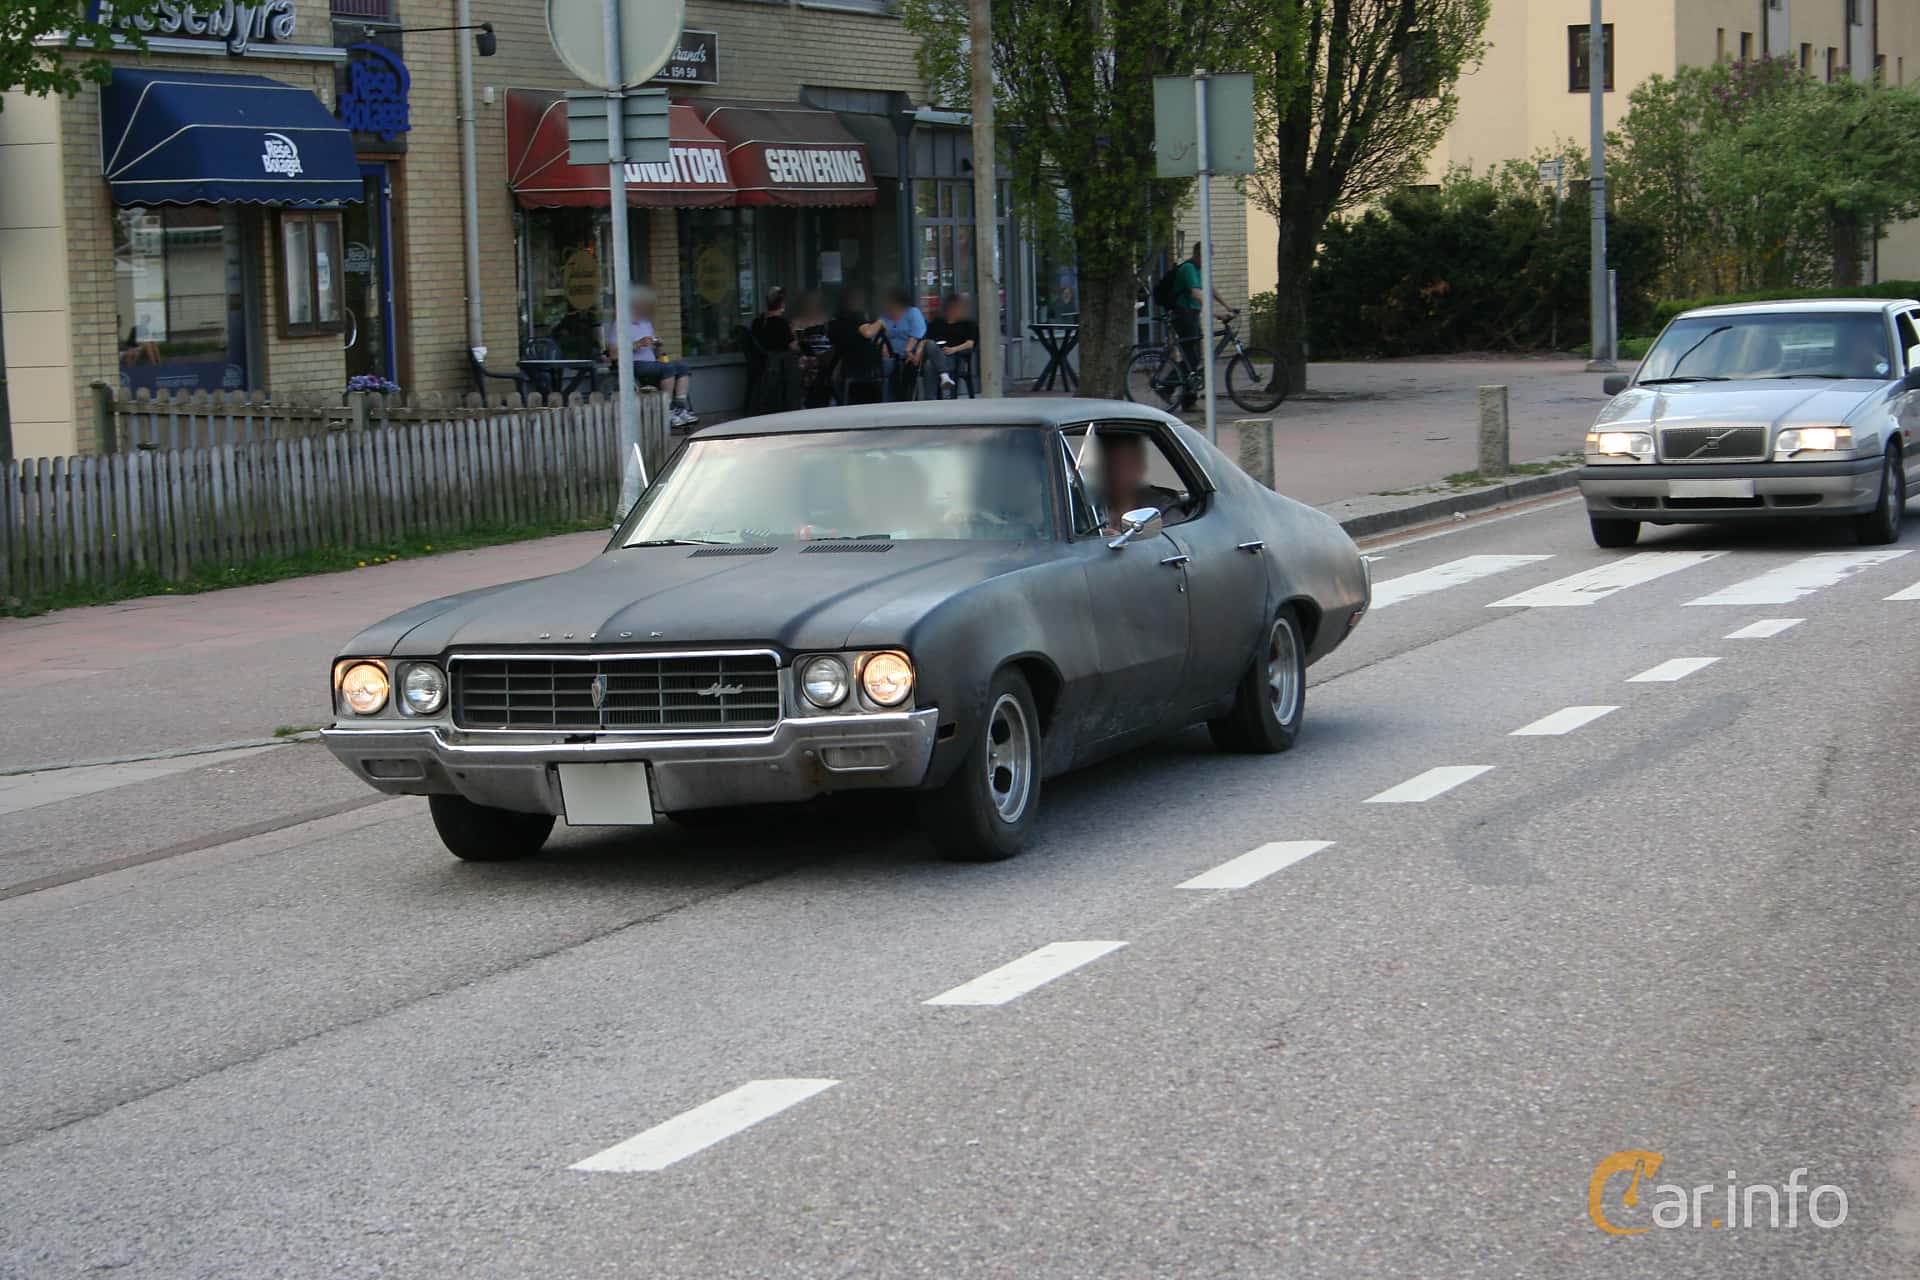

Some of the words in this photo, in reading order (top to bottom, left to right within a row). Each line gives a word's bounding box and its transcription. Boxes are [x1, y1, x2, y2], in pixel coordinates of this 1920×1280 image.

[264, 140, 291, 159] Rese
[624, 147, 729, 183] ONDITORI
[765, 148, 867, 183] SERVERING
